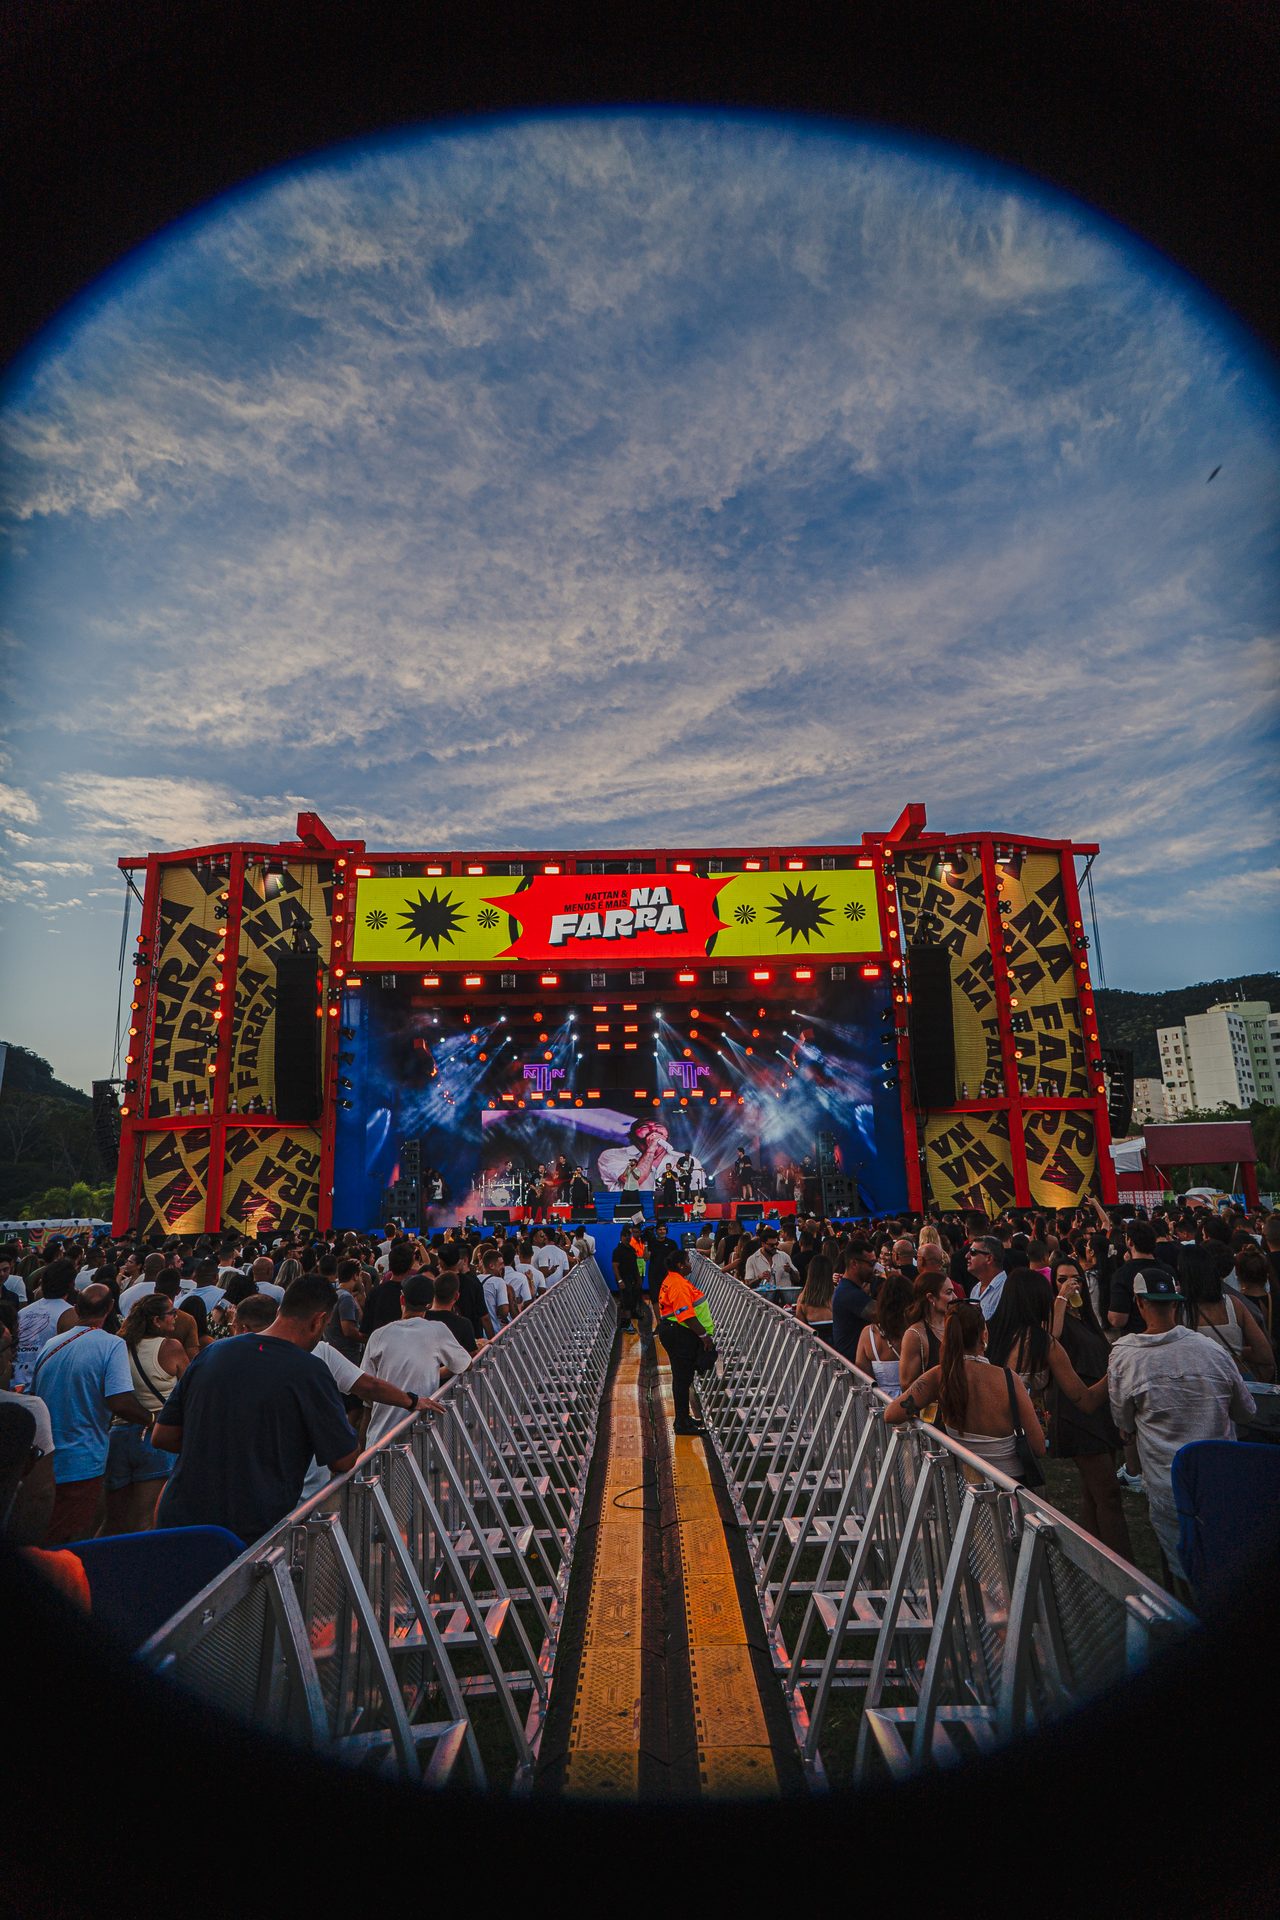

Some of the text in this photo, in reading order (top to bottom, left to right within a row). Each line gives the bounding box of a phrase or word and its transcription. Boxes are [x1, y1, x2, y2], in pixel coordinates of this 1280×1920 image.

[563, 902, 596, 912] MENOS
[605, 899, 628, 908] MAIS
[585, 889, 628, 901] NATTAN &
[630, 886, 670, 906] NA
[242, 896, 314, 949] NA
[548, 904, 684, 944] FARRA
[954, 968, 993, 1013] NA
